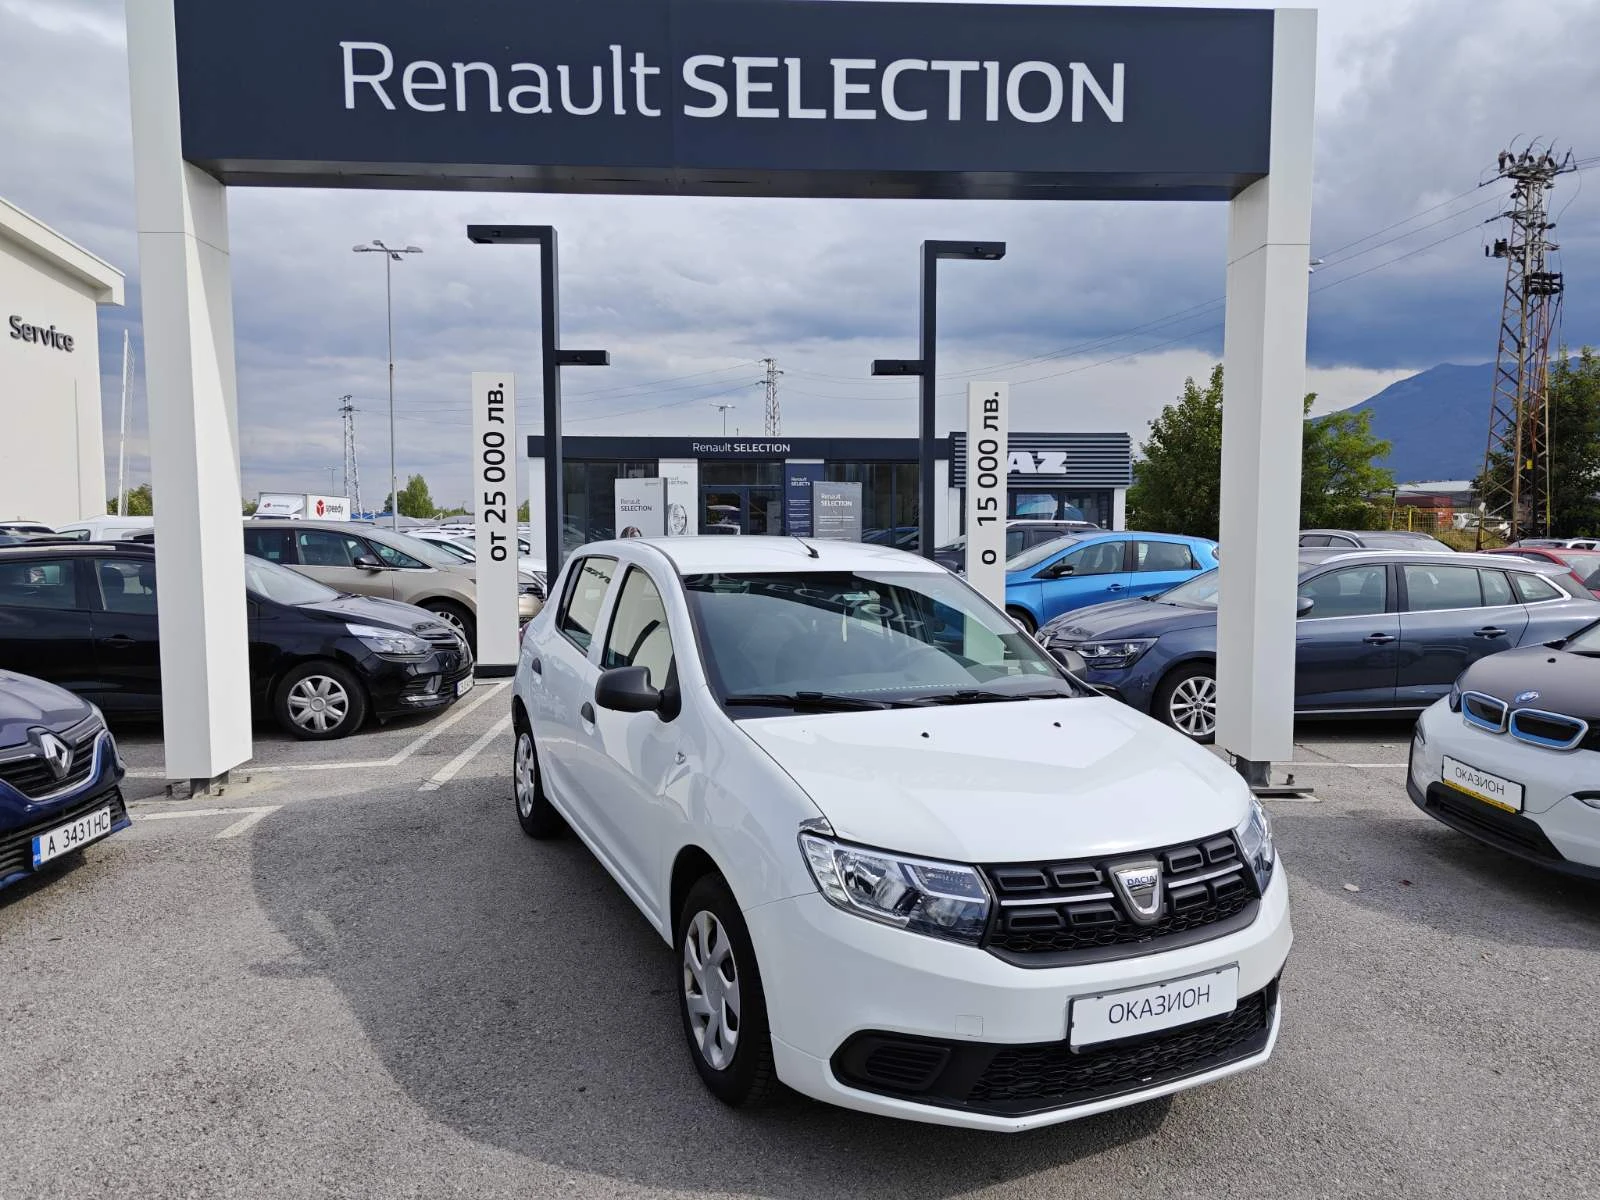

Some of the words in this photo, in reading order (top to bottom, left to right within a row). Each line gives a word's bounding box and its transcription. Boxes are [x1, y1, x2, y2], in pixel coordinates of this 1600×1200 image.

[339, 41, 661, 117] Renault
[683, 54, 1125, 123] SELECTION
[9, 315, 74, 353] Service
[488, 382, 504, 424] лв.
[984, 391, 999, 431] лв.
[483, 431, 506, 483] 000
[692, 442, 731, 453] Renault
[733, 443, 791, 453] SELECTION
[978, 439, 998, 488] 000
[1007, 451, 1067, 474] AZ
[484, 491, 506, 523] 25
[977, 496, 997, 527] 15
[490, 531, 507, 562] от
[1455, 767, 1505, 795] ОКАЗИОН
[48, 835, 56, 856] A
[63, 818, 91, 849] 3431
[1108, 984, 1211, 1024] ОКАЗИОН
